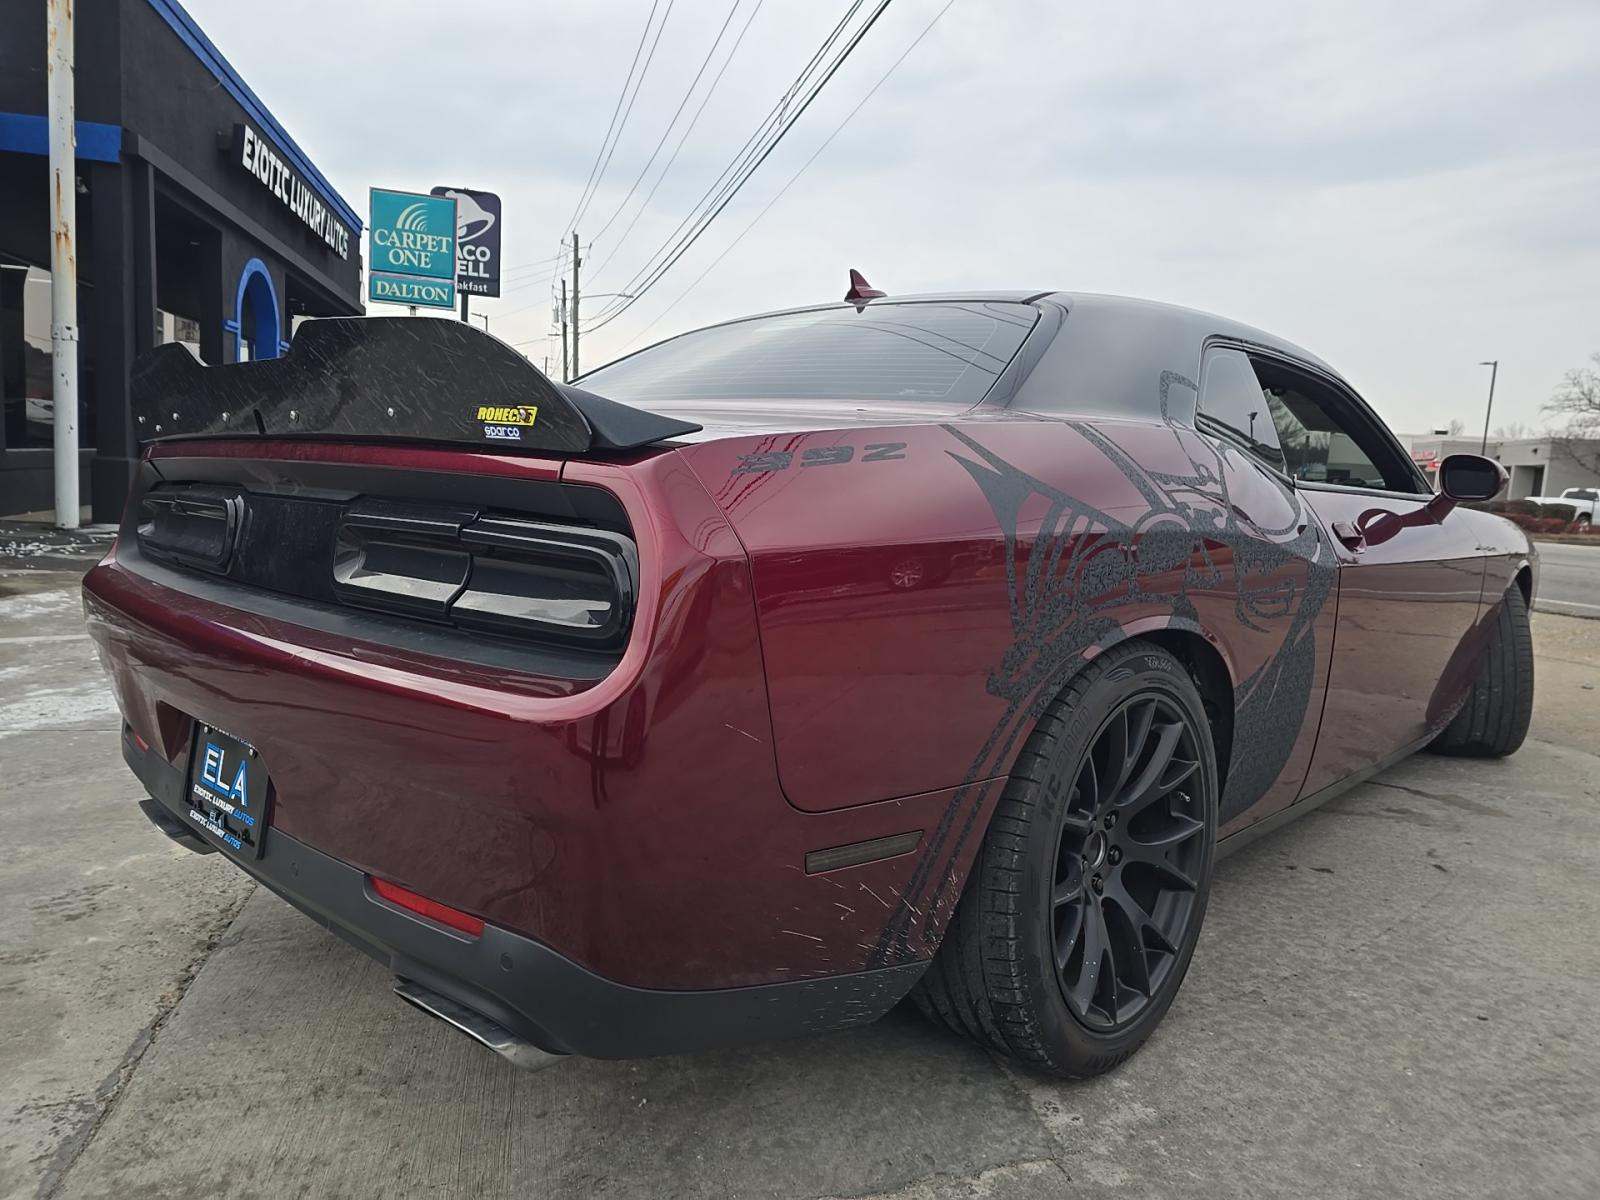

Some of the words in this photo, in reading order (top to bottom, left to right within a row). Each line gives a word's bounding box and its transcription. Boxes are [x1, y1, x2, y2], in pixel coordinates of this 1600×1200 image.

[242, 125, 291, 206] EXOTIC
[290, 174, 326, 237] LUXURY
[325, 212, 349, 261] AUTOS
[374, 228, 452, 254] CARPET
[388, 248, 432, 269] ONE
[458, 244, 491, 262] CO
[457, 260, 490, 278] ELL
[375, 280, 449, 302] DALTON
[457, 281, 488, 293] akfast
[484, 426, 520, 438] sparco
[202, 743, 248, 807] ELA
[212, 796, 235, 815] LUXURY
[233, 808, 256, 827] AUTOS
[223, 833, 242, 850] AUTOS
